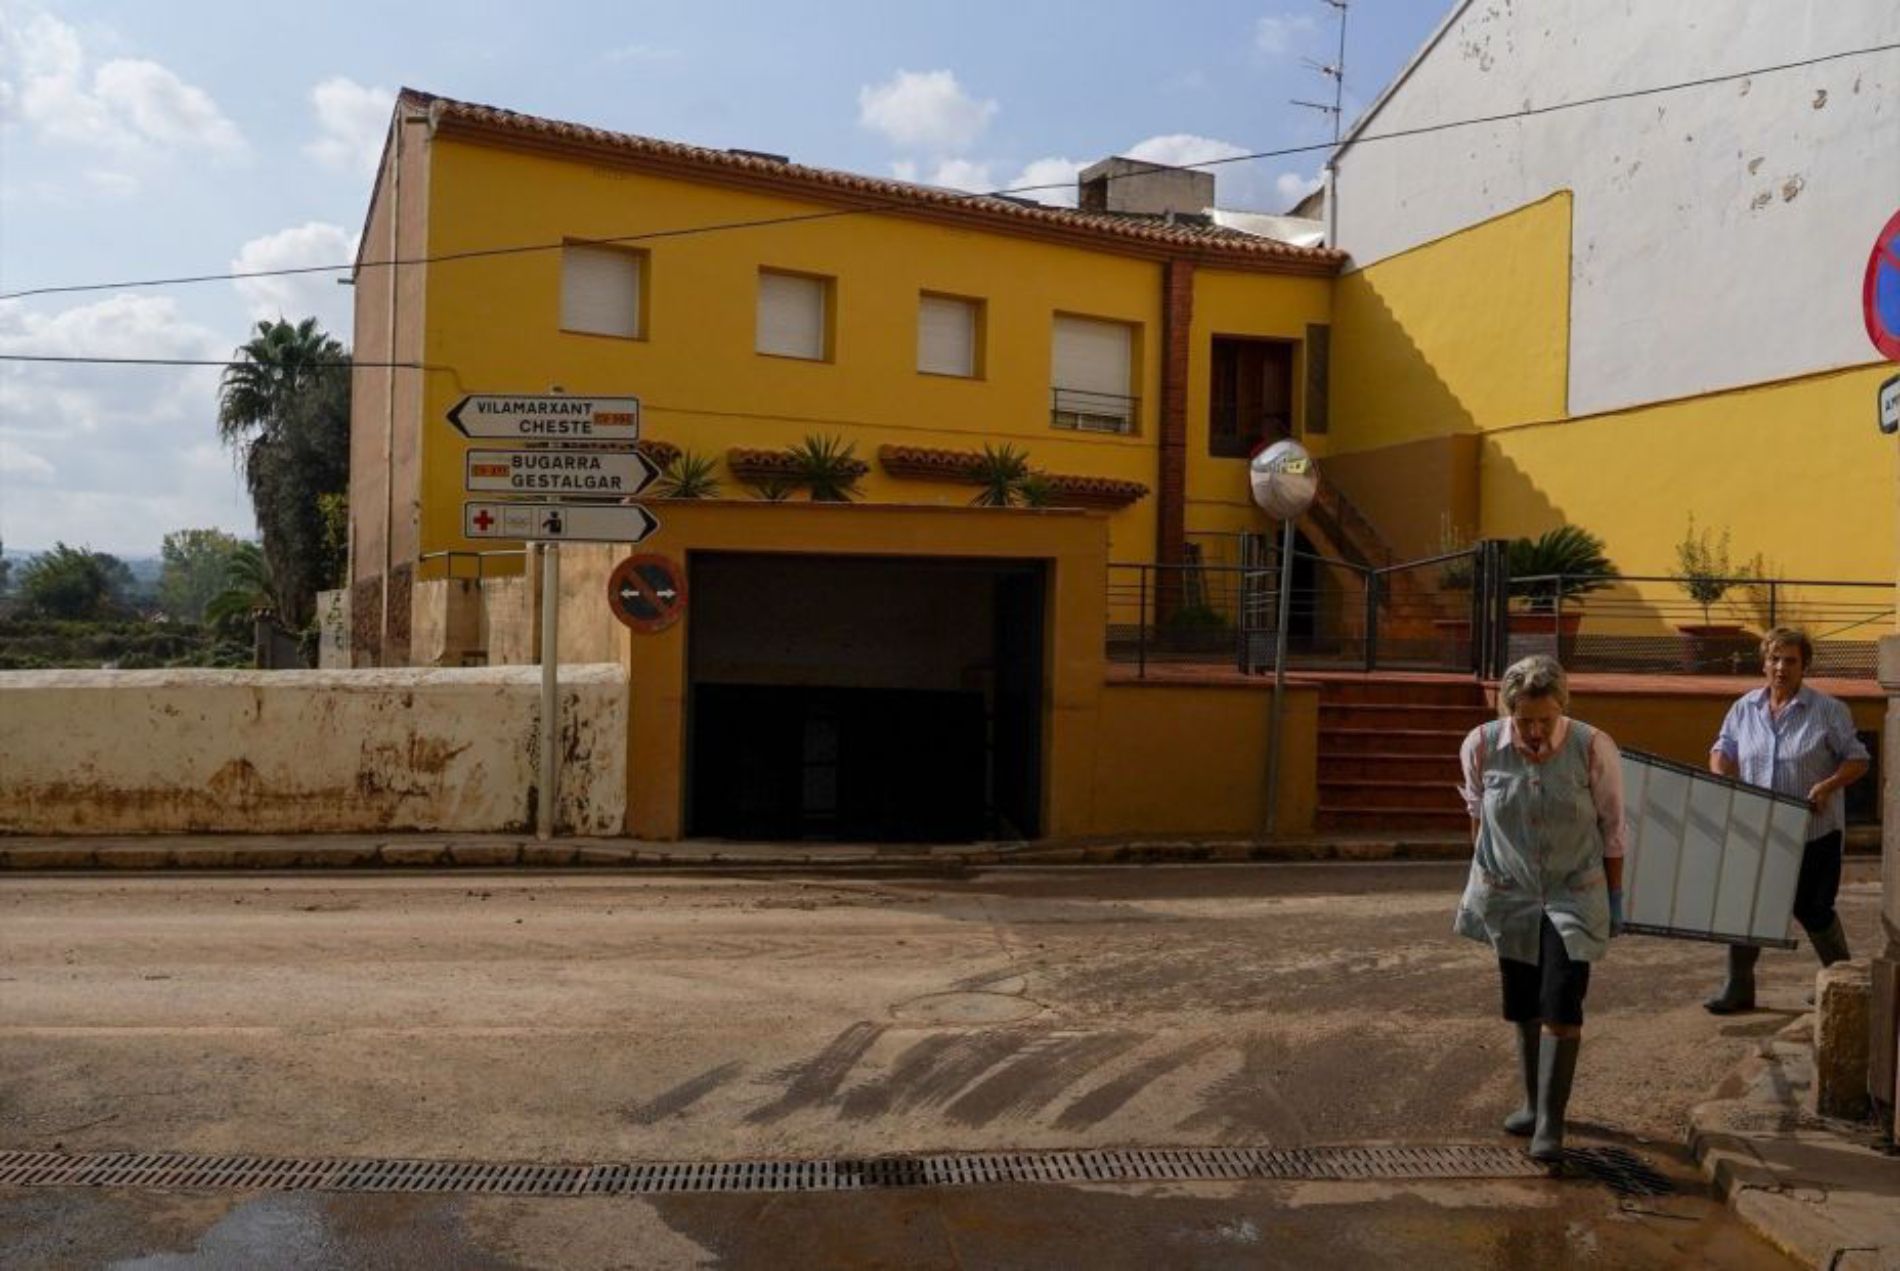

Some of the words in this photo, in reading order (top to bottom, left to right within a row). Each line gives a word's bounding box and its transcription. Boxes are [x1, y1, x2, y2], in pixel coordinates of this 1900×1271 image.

[477, 402, 593, 415] VILAMARXANT
[519, 419, 592, 434] CHESTE
[511, 455, 601, 470] BUGARRA
[511, 474, 622, 490] GESTALGAR
